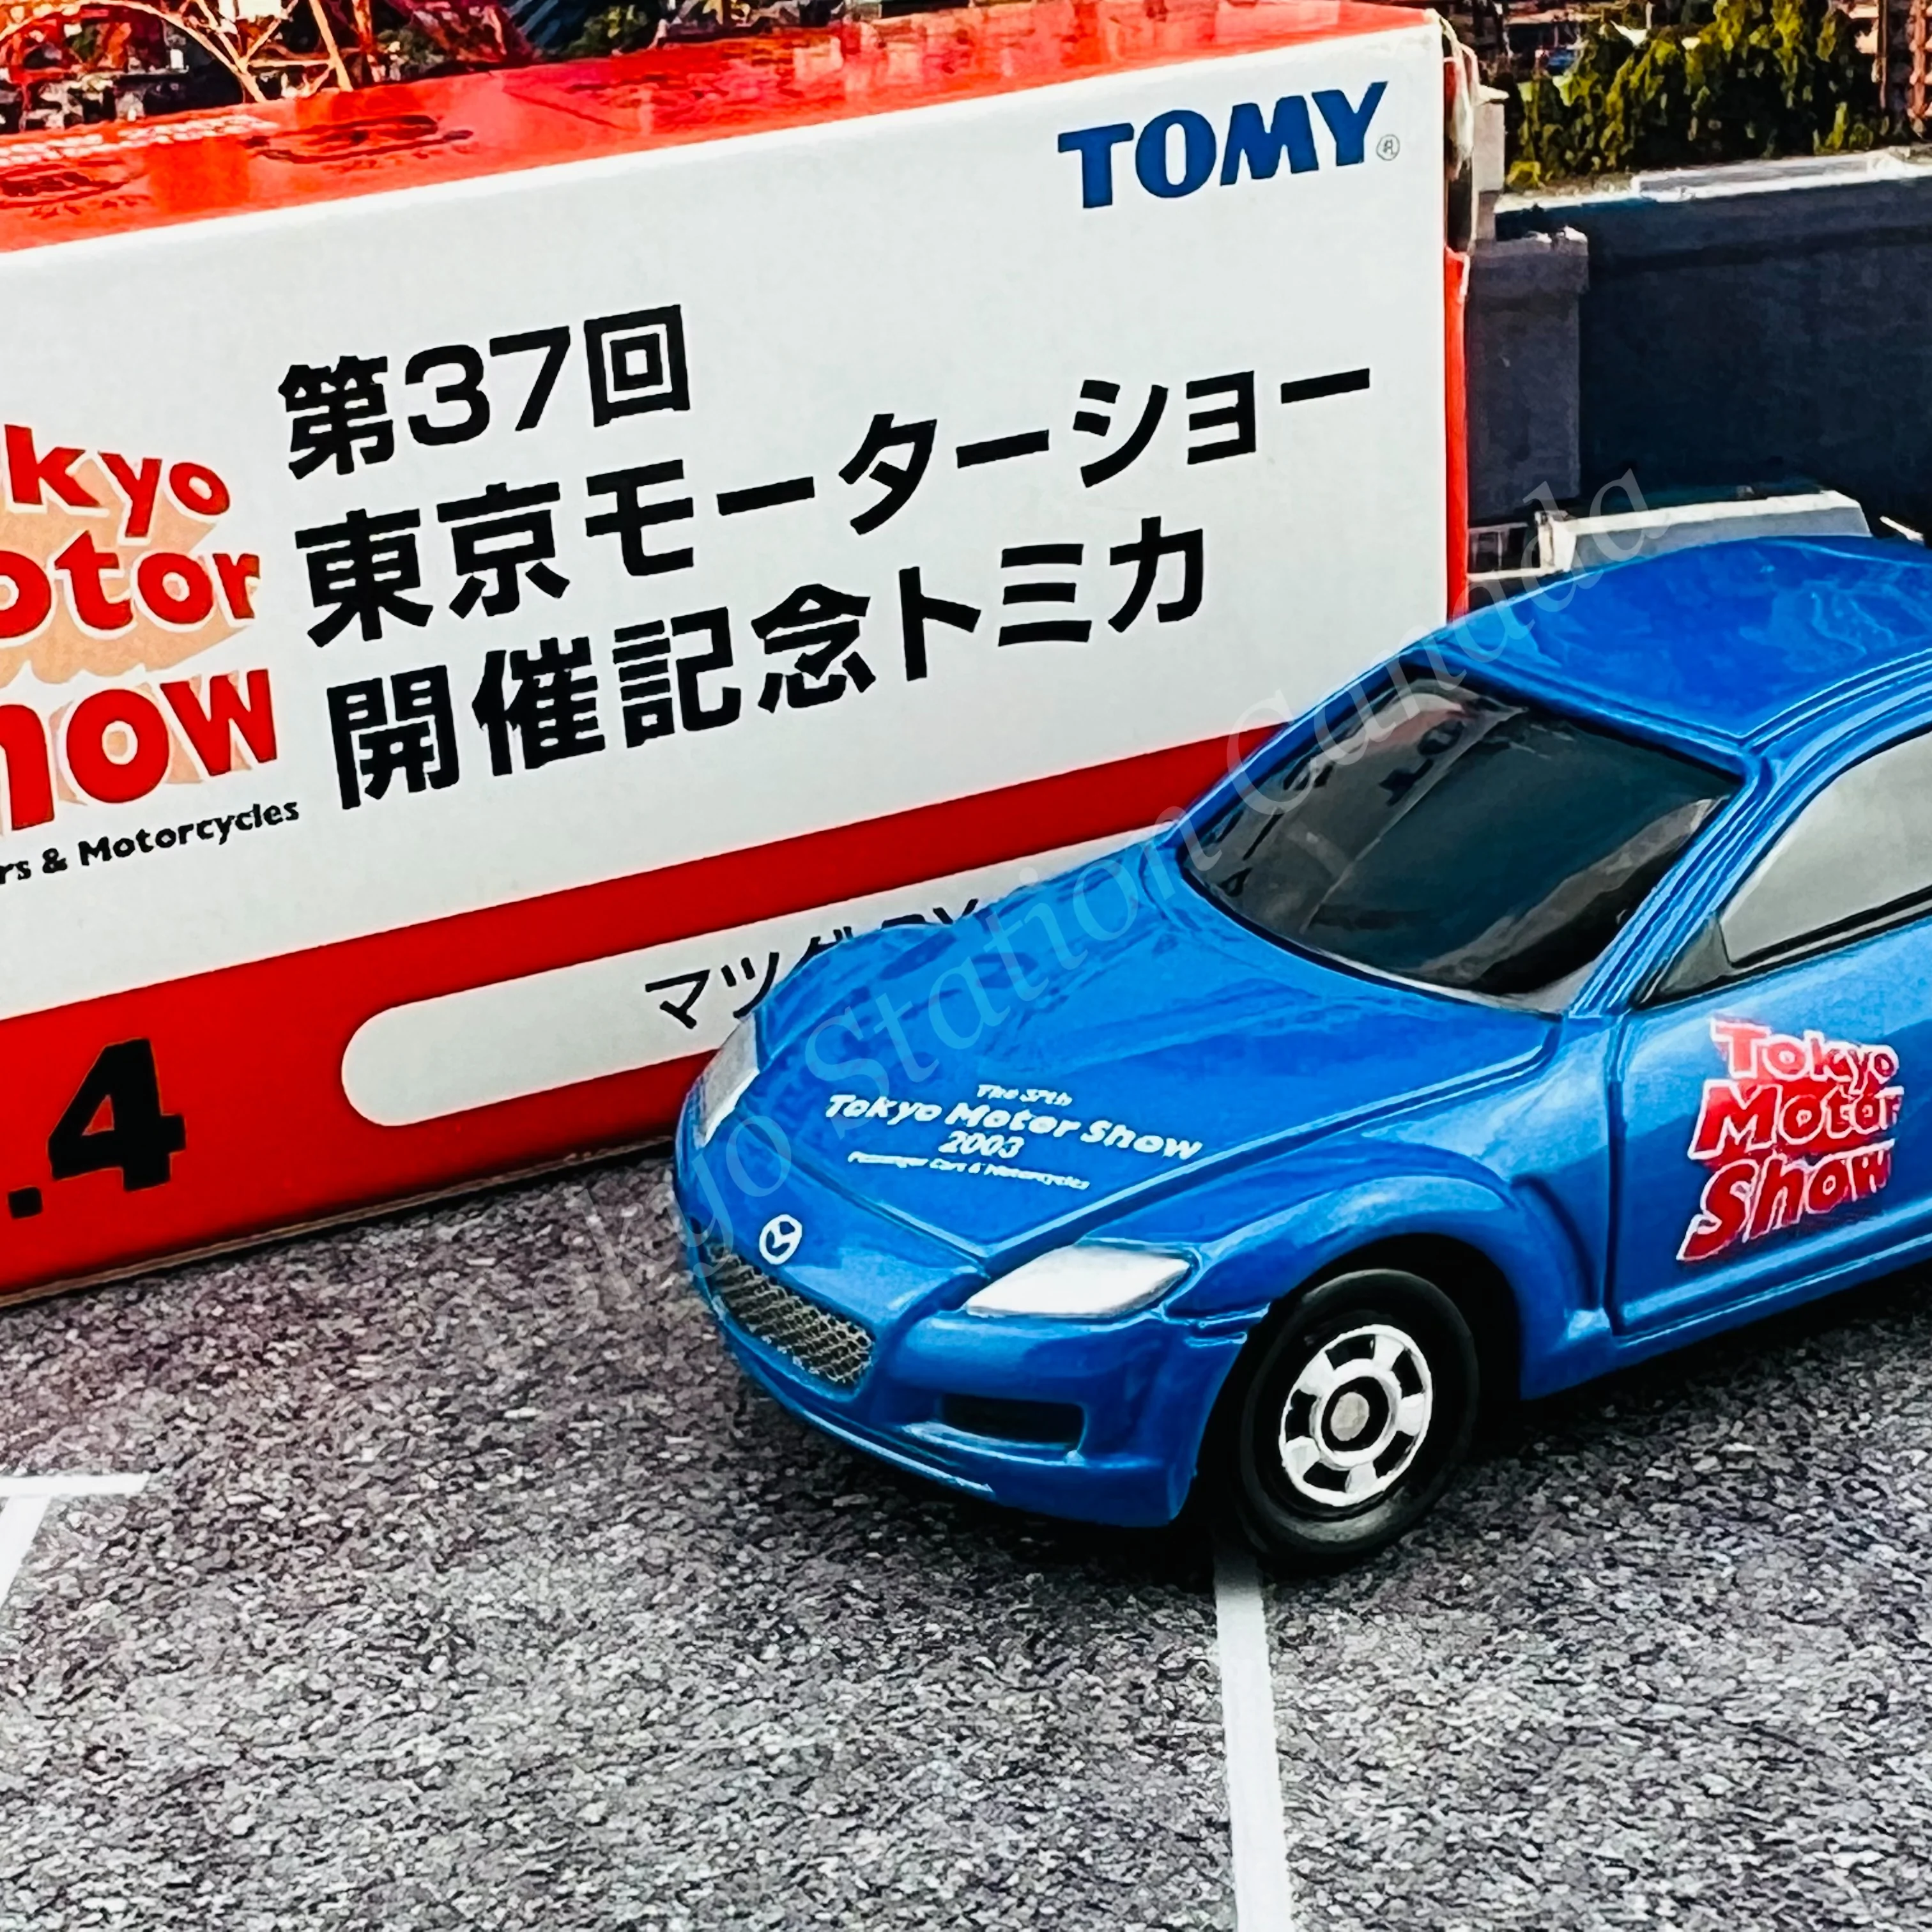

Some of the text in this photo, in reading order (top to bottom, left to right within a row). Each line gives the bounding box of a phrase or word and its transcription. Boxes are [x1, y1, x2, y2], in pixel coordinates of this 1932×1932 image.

[277, 303, 691, 480] 第37回
[295, 367, 1370, 648] 東京モーターショー
[326, 516, 1204, 809] 開催記念トミカ
[42, 847, 68, 874] &
[77, 801, 300, 866] Motorcycles
[1709, 1016, 1900, 1095] Tokyo
[825, 1094, 1204, 1160] Tokyo Motor Show
[937, 1130, 1025, 1159] 2003
[1687, 1078, 1905, 1161] Motor
[1675, 1139, 1896, 1262] Show
